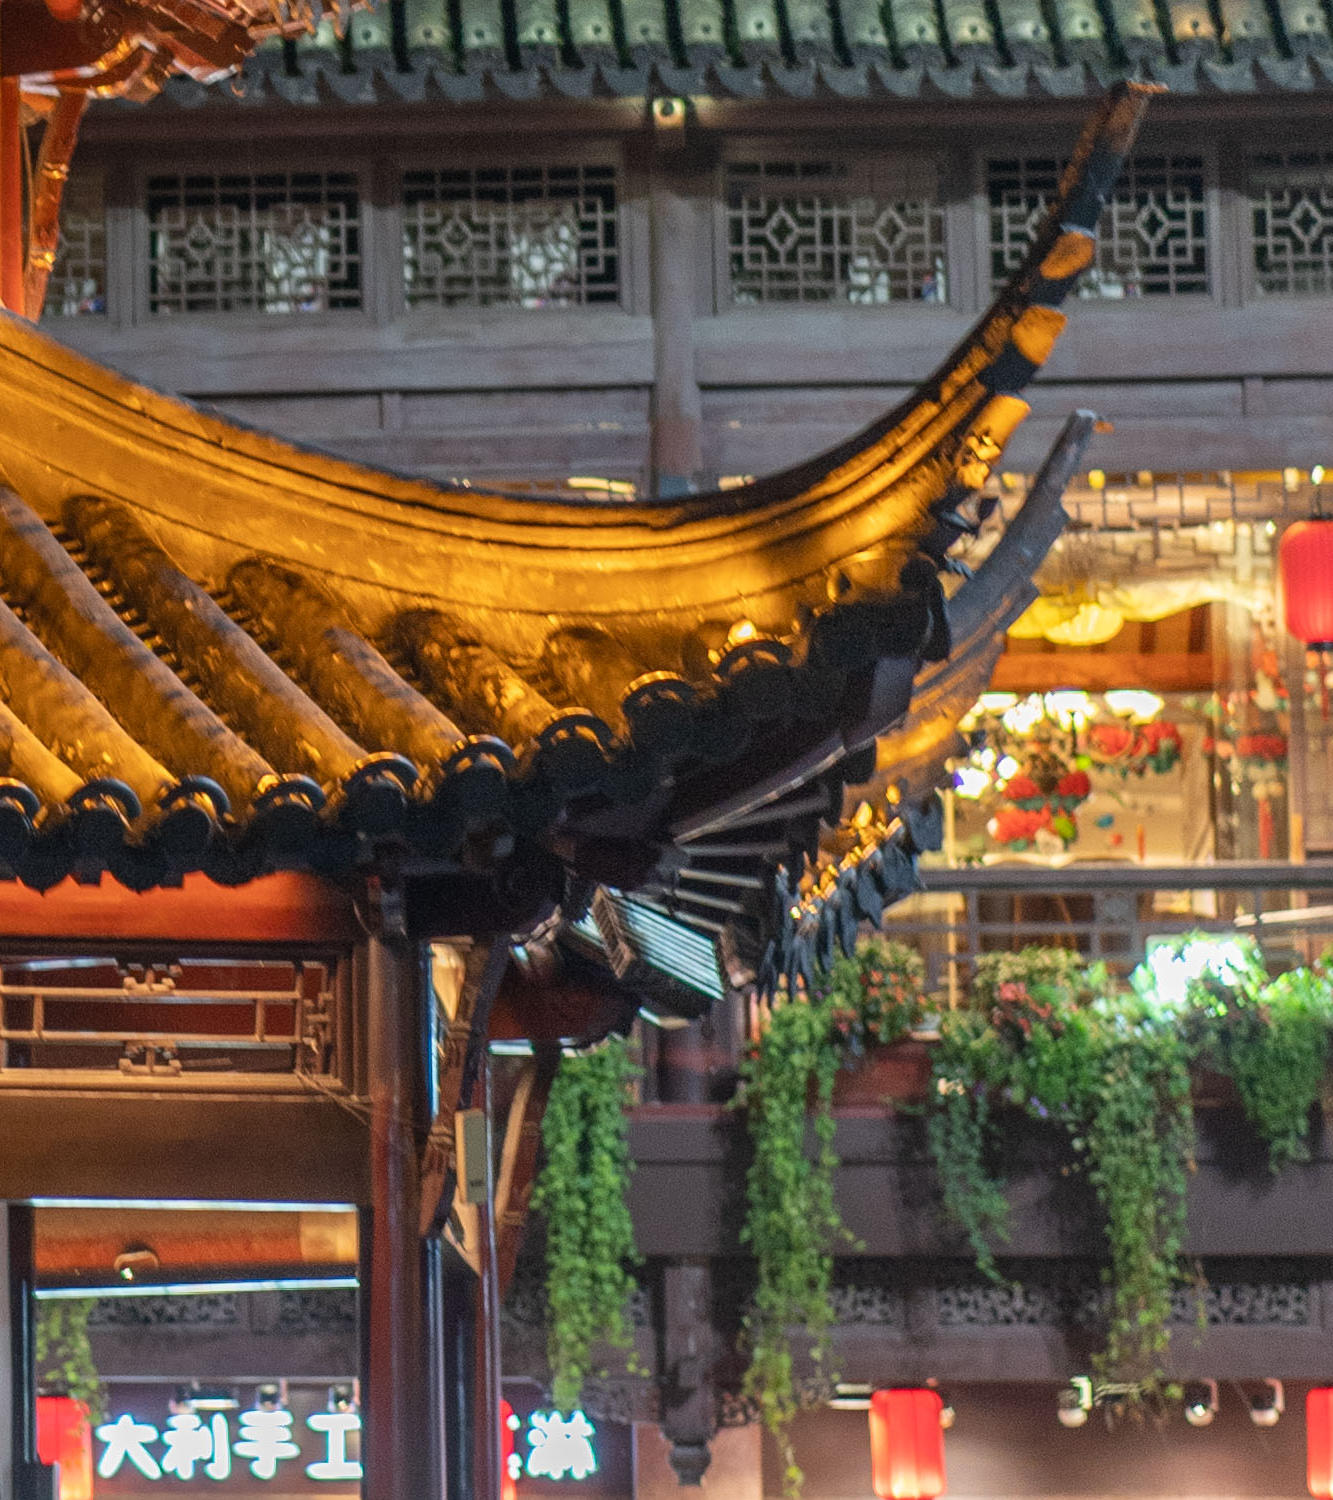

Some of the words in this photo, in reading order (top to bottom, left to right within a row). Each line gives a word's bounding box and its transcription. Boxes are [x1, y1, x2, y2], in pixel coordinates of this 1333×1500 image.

[96, 1410, 597, 1480] 大利手工淋
